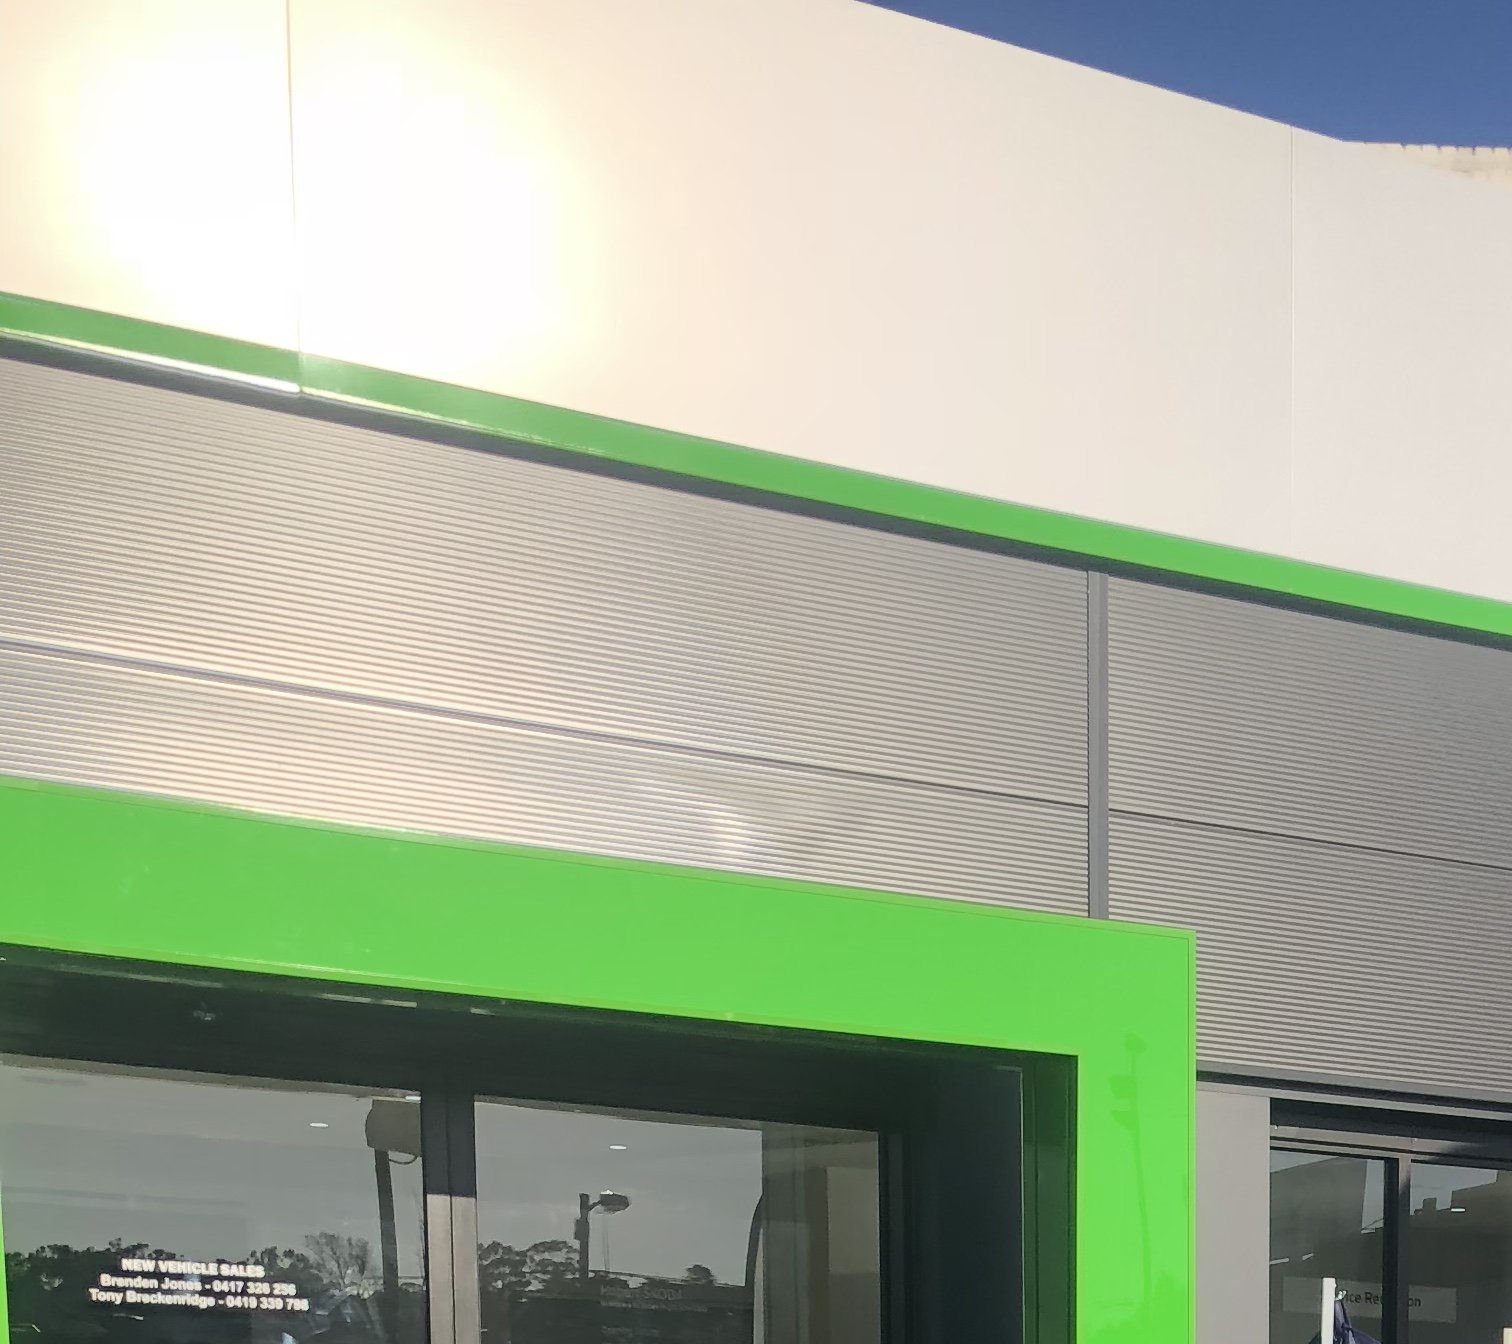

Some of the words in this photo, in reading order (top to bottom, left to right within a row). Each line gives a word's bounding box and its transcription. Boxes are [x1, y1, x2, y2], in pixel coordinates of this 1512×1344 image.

[121, 1258, 156, 1273] NEW
[158, 1260, 219, 1276] VEHICLE
[219, 1263, 266, 1279] SALES
[161, 1276, 203, 1292] Jones
[88, 1287, 124, 1305] Tony
